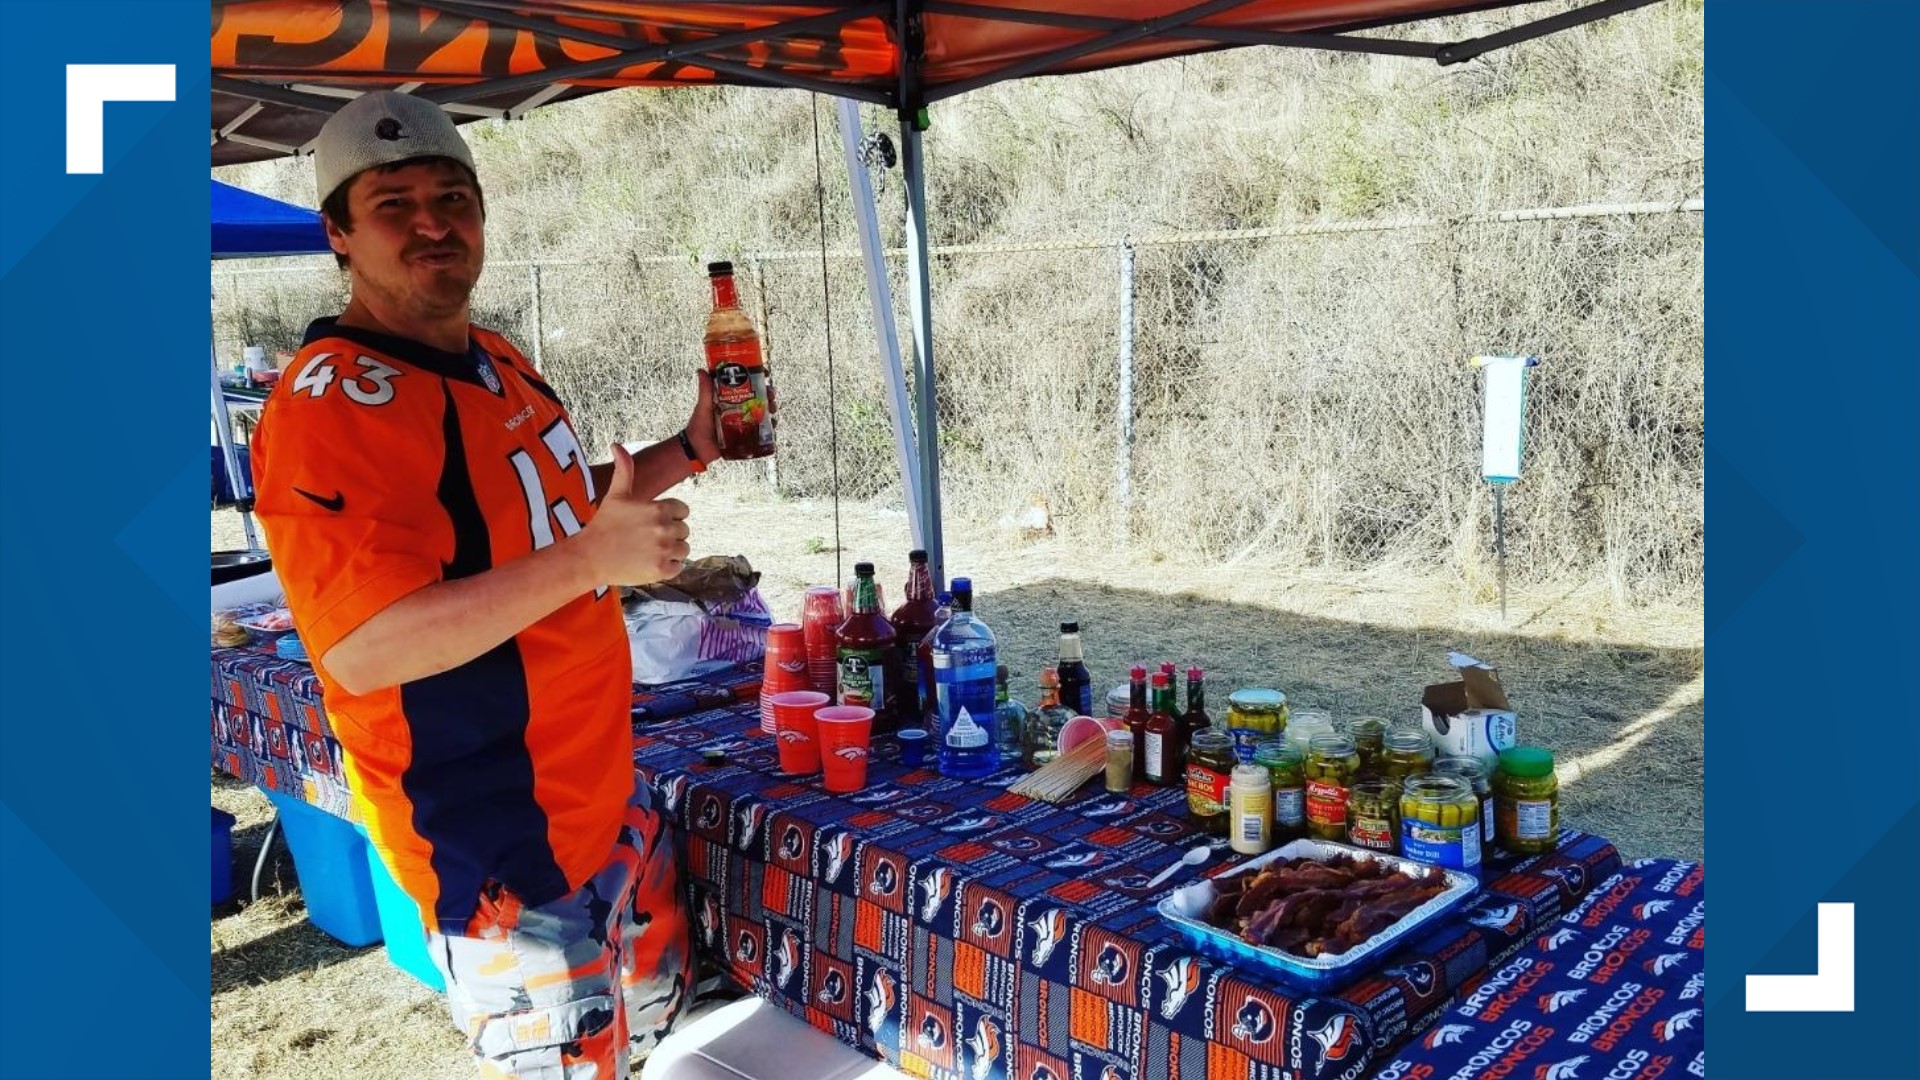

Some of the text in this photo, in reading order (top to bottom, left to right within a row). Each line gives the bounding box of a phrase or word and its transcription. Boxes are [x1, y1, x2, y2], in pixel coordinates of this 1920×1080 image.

[292, 353, 402, 405] 43
[724, 366, 740, 385] T
[848, 658, 861, 673] T
[802, 881, 813, 1004] BRONCOS BRONCOS
[927, 933, 938, 998] BRONCOS
[854, 956, 865, 1022] BRONCOS
[898, 918, 908, 1052] BRONCOS BRONCOS
[1005, 963, 1015, 1032] BRONCOS
[1039, 979, 1049, 1047] BRONCOS
[1457, 956, 1534, 1017] BRONCOS
[1567, 981, 1642, 1043] BRONCOS
[956, 1003, 965, 1072] BRONCOS
[1129, 1012, 1142, 1080] BRONCO
[1591, 987, 1665, 1051] BRONCOS
